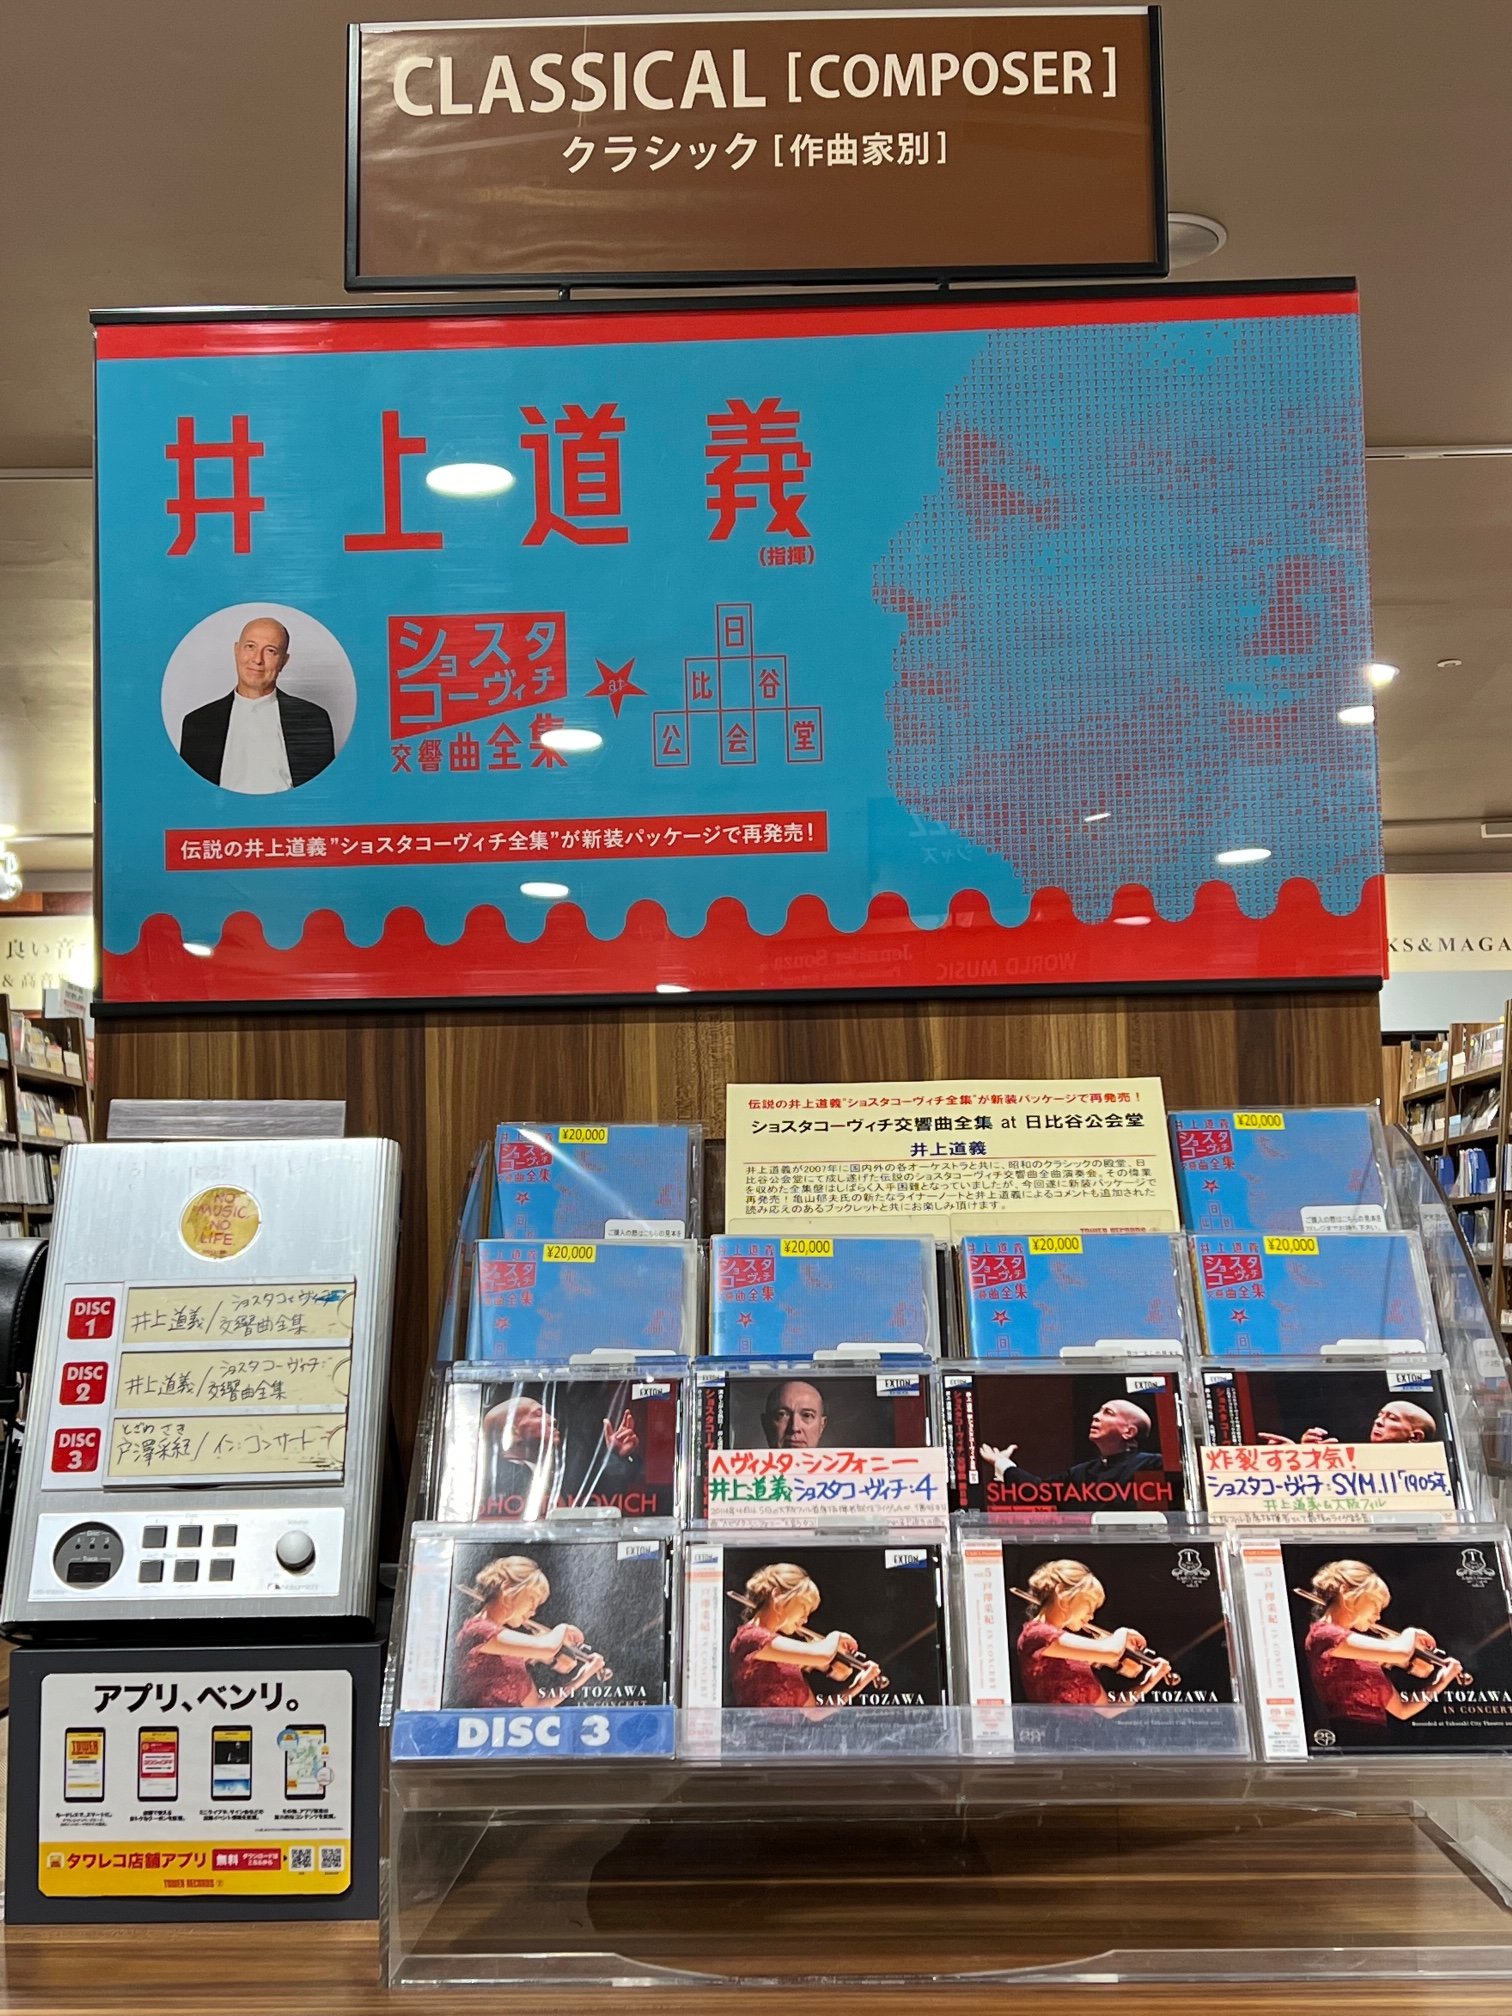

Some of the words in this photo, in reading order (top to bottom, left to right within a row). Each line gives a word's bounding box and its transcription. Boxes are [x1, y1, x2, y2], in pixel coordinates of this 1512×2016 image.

[392, 48, 767, 117] CLASSICAL
[787, 45, 1118, 103] [COMPOSER]
[561, 133, 759, 173] クラシック
[1001, 1116, 1017, 1129] at
[1026, 1112, 1145, 1129] 日比谷公会堂
[1237, 1113, 1283, 1128] ¥20,000
[562, 1128, 606, 1142] ¥20,000
[910, 1141, 987, 1157] 井上道義
[197, 1204, 247, 1219] MUSIC
[200, 1231, 233, 1246] LIFE
[1032, 1238, 1079, 1252] ¥20,000
[1268, 1238, 1315, 1253] ¥20,000
[547, 1246, 594, 1260] ¥20,000
[784, 1240, 830, 1255] ¥20,000
[74, 1301, 110, 1317] DISC
[84, 1319, 96, 1337] 1
[67, 1366, 103, 1381] DISC
[884, 1379, 912, 1389] EXTON
[75, 1384, 91, 1402] 2
[59, 1433, 96, 1448] DISC
[66, 1451, 83, 1469] 3
[986, 1482, 1173, 1503] SHOSTAKOVICH
[94, 1682, 300, 1714] アプリ、ベンリ。
[538, 1686, 576, 1699] SAKI
[581, 1685, 647, 1698] TOZAWA
[816, 1694, 853, 1706] SAKI
[859, 1693, 925, 1706] TOZAWA
[1108, 1690, 1146, 1702] SAKI
[1151, 1690, 1218, 1703] TOZAWA
[1400, 1690, 1440, 1703] SAKI
[1444, 1690, 1512, 1703] TOZAWA
[1443, 1705, 1456, 1714] IN
[457, 1715, 561, 1748] DISC
[579, 1715, 611, 1747] 3
[67, 1852, 207, 1870] タワレコ店舗アプリ
[216, 1853, 239, 1867] 無料
